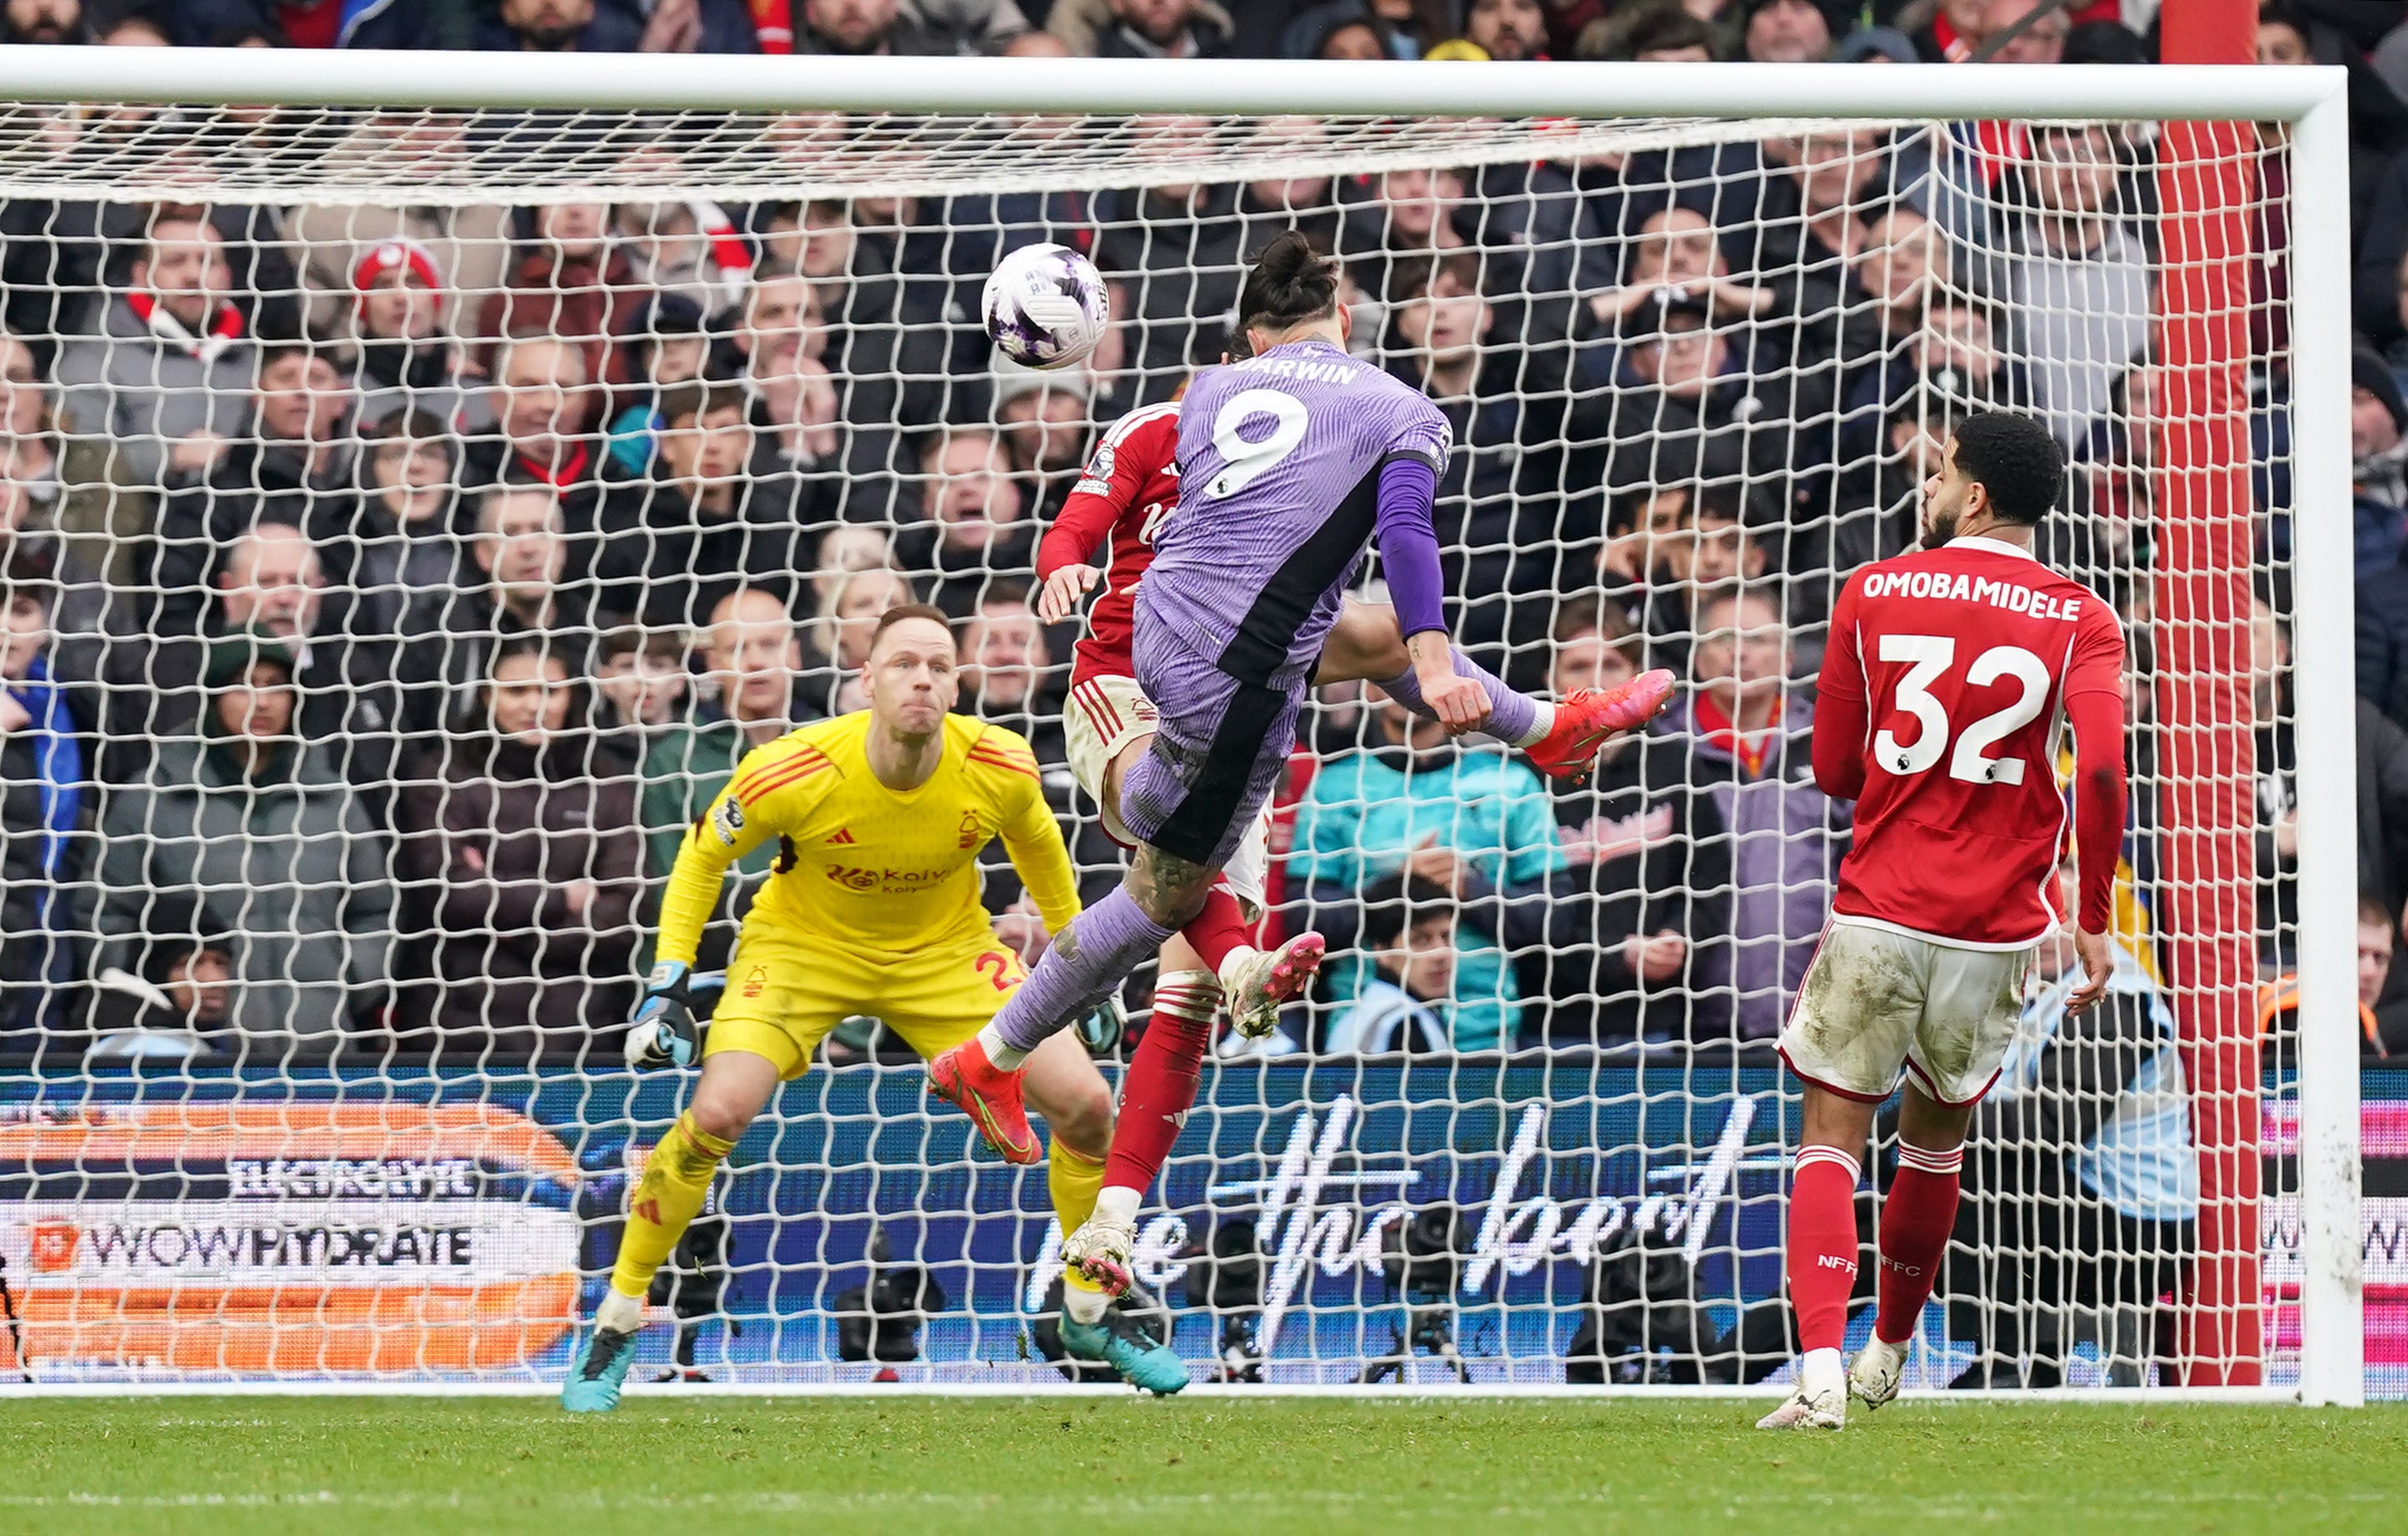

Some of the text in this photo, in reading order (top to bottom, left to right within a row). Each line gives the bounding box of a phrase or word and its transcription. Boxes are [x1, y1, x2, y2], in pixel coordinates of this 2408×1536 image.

[1233, 356, 1358, 384] DARWIN
[1202, 388, 1309, 499] 9
[1863, 571, 2082, 622] OMOBAMIDELE
[1874, 634, 2051, 786] 32
[90, 1225, 471, 1265] WOWHYDRATE
